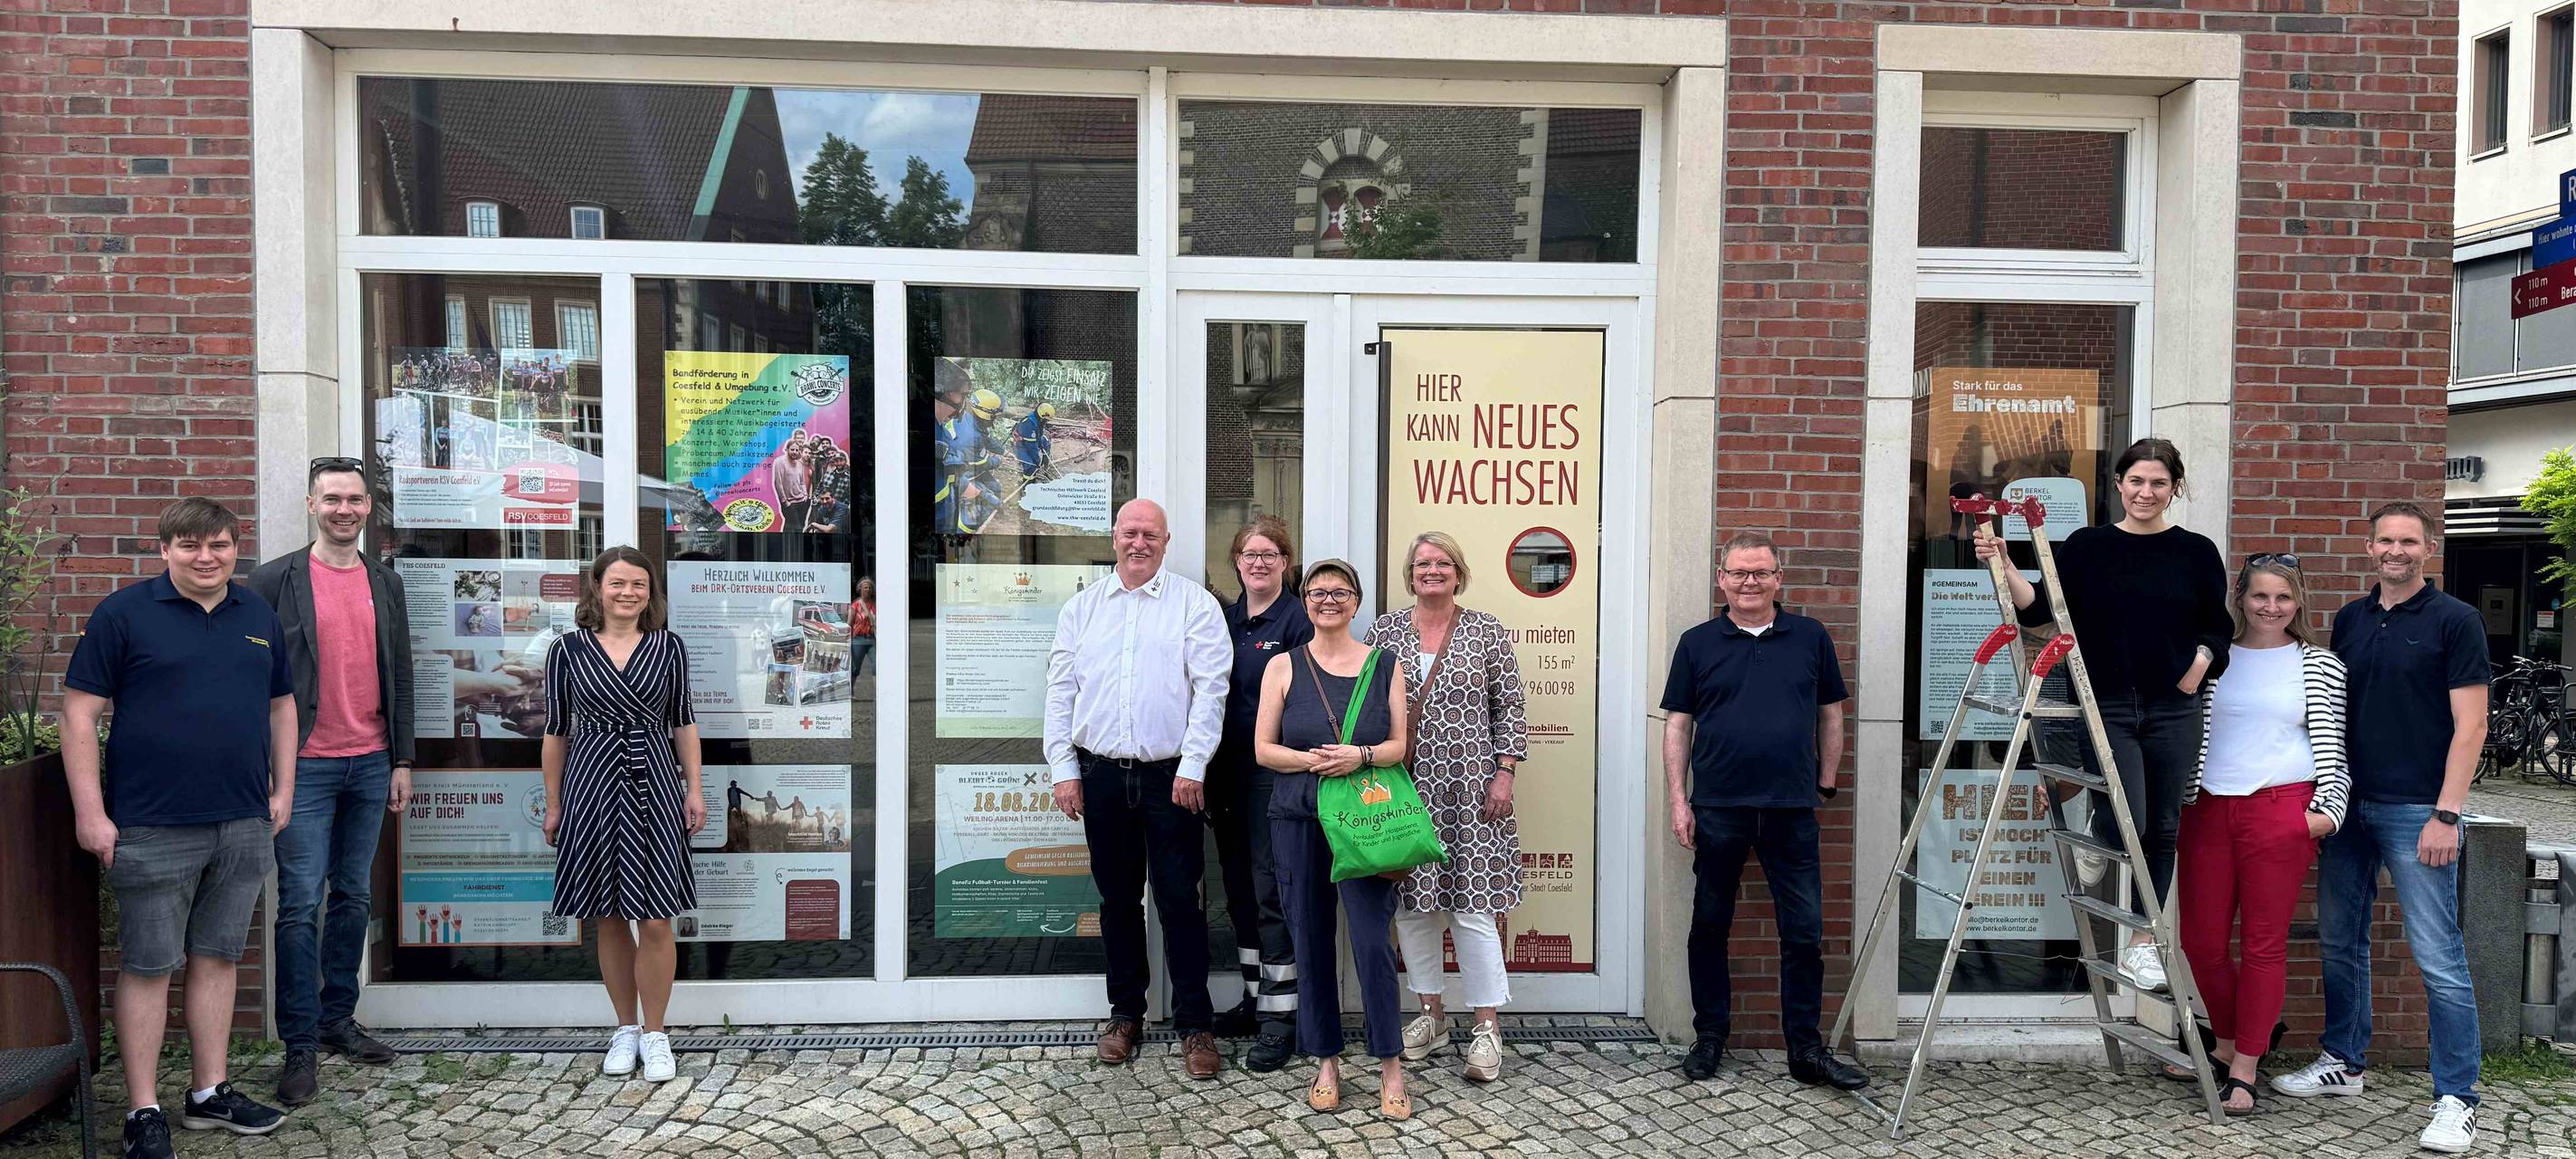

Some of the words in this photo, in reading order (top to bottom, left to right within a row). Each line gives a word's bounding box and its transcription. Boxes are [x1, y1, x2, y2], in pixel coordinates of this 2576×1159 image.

[2538, 233, 2550, 244] Hier
[2552, 225, 2572, 240] wohnte
[2529, 277, 2540, 290] 110
[2529, 296, 2540, 310] 110
[673, 369, 738, 380] Bandförderung
[1037, 369, 1063, 382] ZEIGST
[1066, 368, 1107, 387] EINSATZ
[673, 381, 711, 390] Coesfeld
[715, 382, 721, 390] &
[725, 382, 768, 393] Umgebung
[772, 384, 791, 393] e.V.
[800, 381, 816, 394] BRAWL
[816, 380, 841, 391] CONCERTS
[1417, 374, 1463, 402] HIER
[1952, 380, 1982, 390] Stark
[1984, 380, 2000, 391] für
[2002, 381, 2023, 391] das
[726, 398, 764, 406] Netzwerk
[1024, 386, 1039, 398] WIR
[1045, 385, 1081, 403] ZEIGEN
[1086, 392, 1100, 406] WIE
[1952, 393, 2075, 414] Ehrenamt
[737, 420, 806, 428] Musikbegeisterte
[1407, 413, 1460, 442] KANN
[1473, 404, 1579, 450] NEUES
[742, 462, 772, 470] zornige
[398, 474, 439, 486] Radsportverein
[439, 475, 449, 484] RSV
[451, 475, 472, 485] Coesfeld
[1413, 459, 1579, 505] WACHSEN
[704, 568, 749, 581] HERZLICH
[753, 569, 816, 582] WILLKOMMEN
[1004, 586, 1043, 597] Königskinder
[1931, 592, 1949, 600] Die
[1950, 592, 1974, 600] Welt
[1505, 629, 1520, 644] zu
[1526, 625, 1575, 644] mieten
[1538, 655, 1558, 669] 155
[1561, 655, 1576, 669] m²
[997, 776, 1020, 784] GRÜN!
[410, 793, 430, 804] WIR
[434, 793, 478, 804] FREUEN
[482, 793, 503, 804] UNS
[973, 791, 1060, 812] 18.08.202
[410, 808, 432, 819] AUF
[436, 808, 464, 819] DICH!
[1333, 801, 1423, 831] Königskinder
[1353, 831, 1384, 840] Ambulanter
[1362, 839, 1379, 848] Kinder
[1380, 836, 1391, 844] und
[1392, 829, 1420, 842] Jugendliche
[1993, 828, 2045, 842] NOCH
[1951, 849, 2011, 864] PLTZ
[2015, 846, 2051, 864] FÜR
[1531, 883, 1546, 892] Stadt
[1548, 883, 1573, 892] Coesfeld
[2027, 893, 2046, 906] !!!
